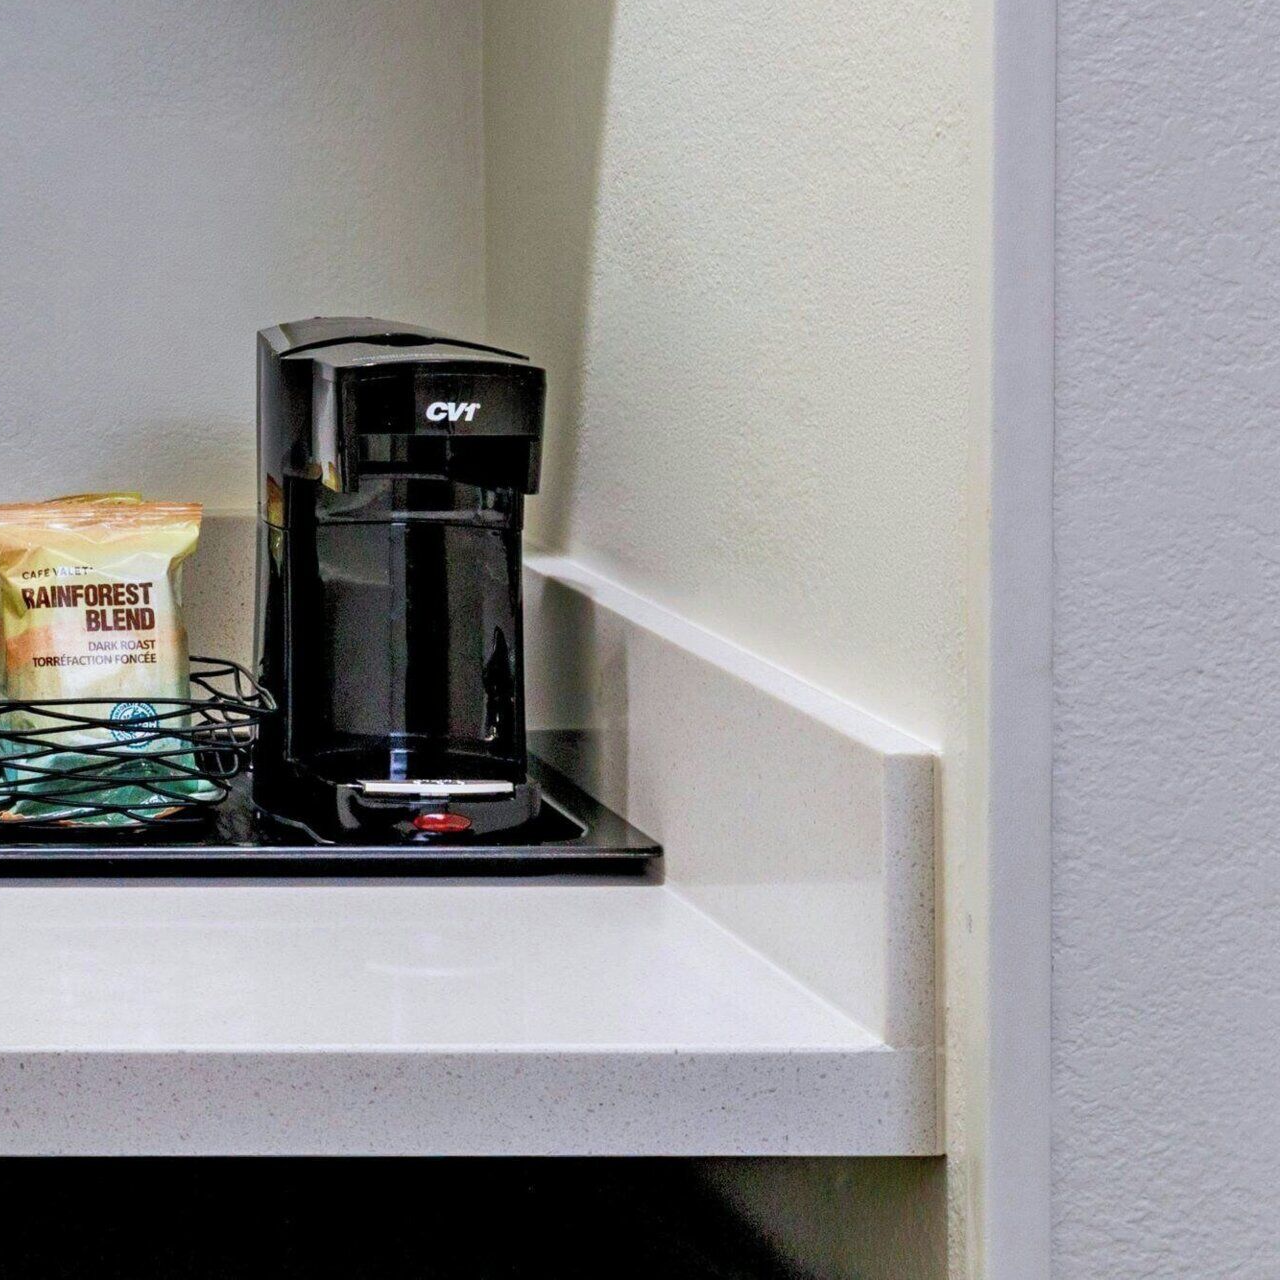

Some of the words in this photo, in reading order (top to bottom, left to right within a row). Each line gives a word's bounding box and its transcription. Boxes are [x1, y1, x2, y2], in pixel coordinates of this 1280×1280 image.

[21, 582, 153, 609] RAINFOREST
[85, 607, 156, 632] BLEND
[88, 640, 118, 651] DARK
[120, 639, 156, 650] ROAST
[32, 654, 112, 667] TORRÉFACTION
[114, 651, 157, 664] FONCÉE
